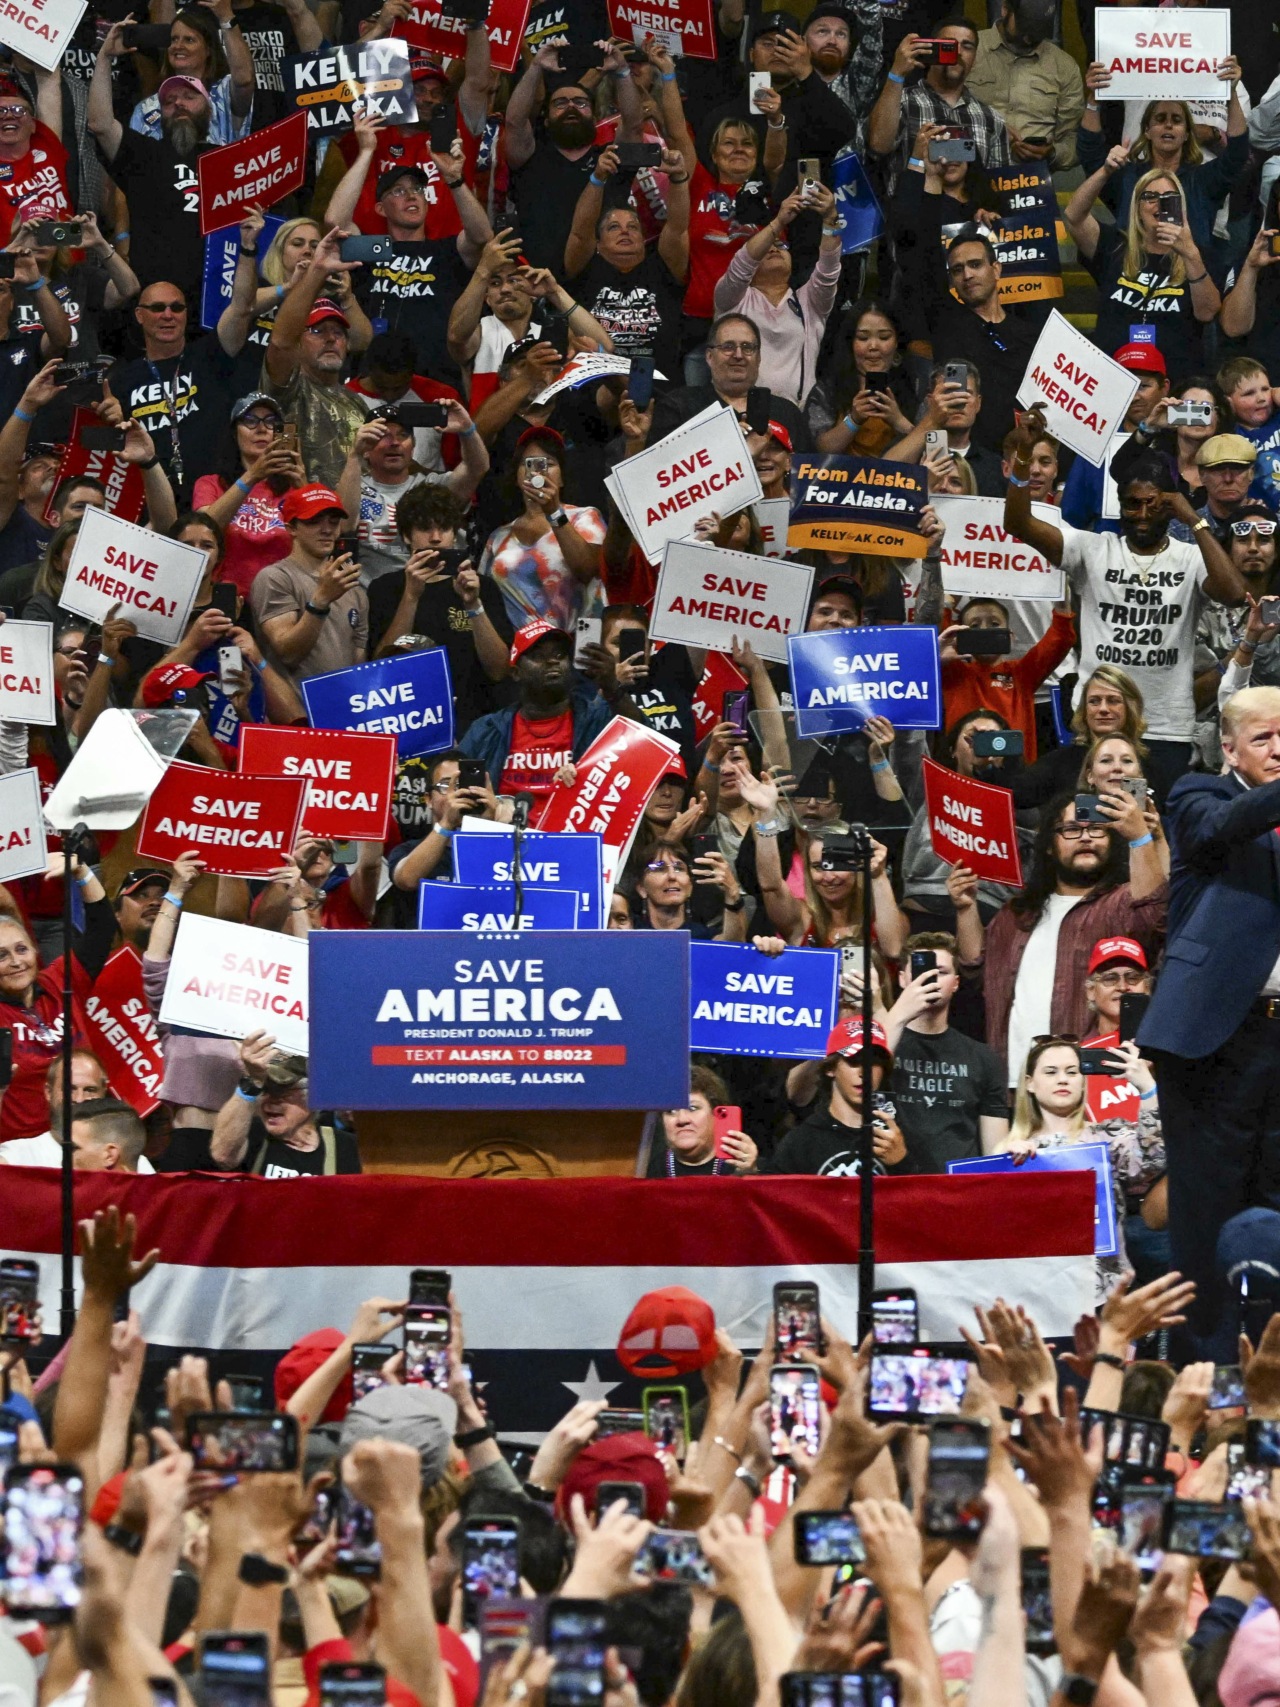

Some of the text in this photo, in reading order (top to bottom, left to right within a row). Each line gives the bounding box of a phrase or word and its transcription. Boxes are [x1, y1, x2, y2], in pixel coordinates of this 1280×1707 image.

[0, 3, 59, 43] ERICA!
[524, 8, 565, 36] ELLY
[616, 7, 703, 37] AMERICA!
[1135, 32, 1192, 48] SAVE
[295, 50, 395, 90] KELLY
[1110, 57, 1218, 75] AMERICA!
[339, 84, 357, 99] for
[307, 97, 404, 129] ALASKA
[233, 146, 282, 179] SAVE
[212, 157, 299, 210] AMERICA!
[994, 245, 1038, 264] laska
[220, 240, 237, 298] SAVE
[371, 278, 434, 298] ALASKA
[600, 287, 649, 305] TRUMP
[997, 281, 1042, 295] AK.COM
[1134, 333, 1152, 341] RALLY
[1053, 352, 1099, 397] SAVE
[131, 371, 194, 407] KELLY
[1031, 365, 1108, 436] AMERICA!
[140, 399, 200, 433] ALASKA
[84, 447, 107, 478] AVE
[656, 448, 713, 488] SAVE
[798, 463, 916, 491] From Alaska
[646, 462, 744, 526] AMERICA!
[805, 485, 909, 513] For Alaska
[104, 545, 159, 582] SAVE
[941, 549, 1052, 574] AMERICA!
[76, 565, 177, 619] AMERICA!
[702, 573, 768, 601] SAVE
[1105, 568, 1185, 589] BLACKS
[1125, 587, 1162, 606] FOR
[668, 597, 792, 634] AMERICA!
[1100, 602, 1182, 627] TRUMP
[1112, 627, 1163, 646] 2020
[832, 652, 900, 676] SAVE
[1096, 647, 1178, 667] GODS2.COM
[0, 676, 41, 696] ICA!
[350, 682, 416, 714] SAVE
[809, 680, 928, 708] AMERICA!
[346, 706, 443, 735] MERICA!
[283, 756, 352, 780] SAVE
[504, 750, 573, 770] TRUMP
[560, 735, 629, 833] AMERICA
[190, 796, 262, 821] SAVE
[309, 789, 379, 812] RICA!
[392, 803, 432, 826] RUM
[588, 770, 631, 832] SAVE
[943, 795, 983, 827] SAVE
[154, 816, 284, 850] AMERICA!
[934, 815, 1009, 860] AMERICA!
[462, 912, 535, 930] SAVE
[222, 952, 292, 985] SAVE
[454, 959, 544, 984] SAVE
[725, 972, 794, 996] SAVE
[375, 987, 622, 1023] AMERICA
[693, 1000, 822, 1028] AMERICA!
[122, 997, 166, 1058] SAVE
[404, 1027, 593, 1039] PRESIDENT DONALD J. TRUMP
[85, 996, 165, 1099] AMERICA!
[405, 1049, 593, 1062] TEXT ALASKA TO 88022
[411, 1072, 585, 1086] ANCHORAGE, ALASKA
[895, 1057, 969, 1078] AMERICAN
[909, 1075, 953, 1093] EAGLE
